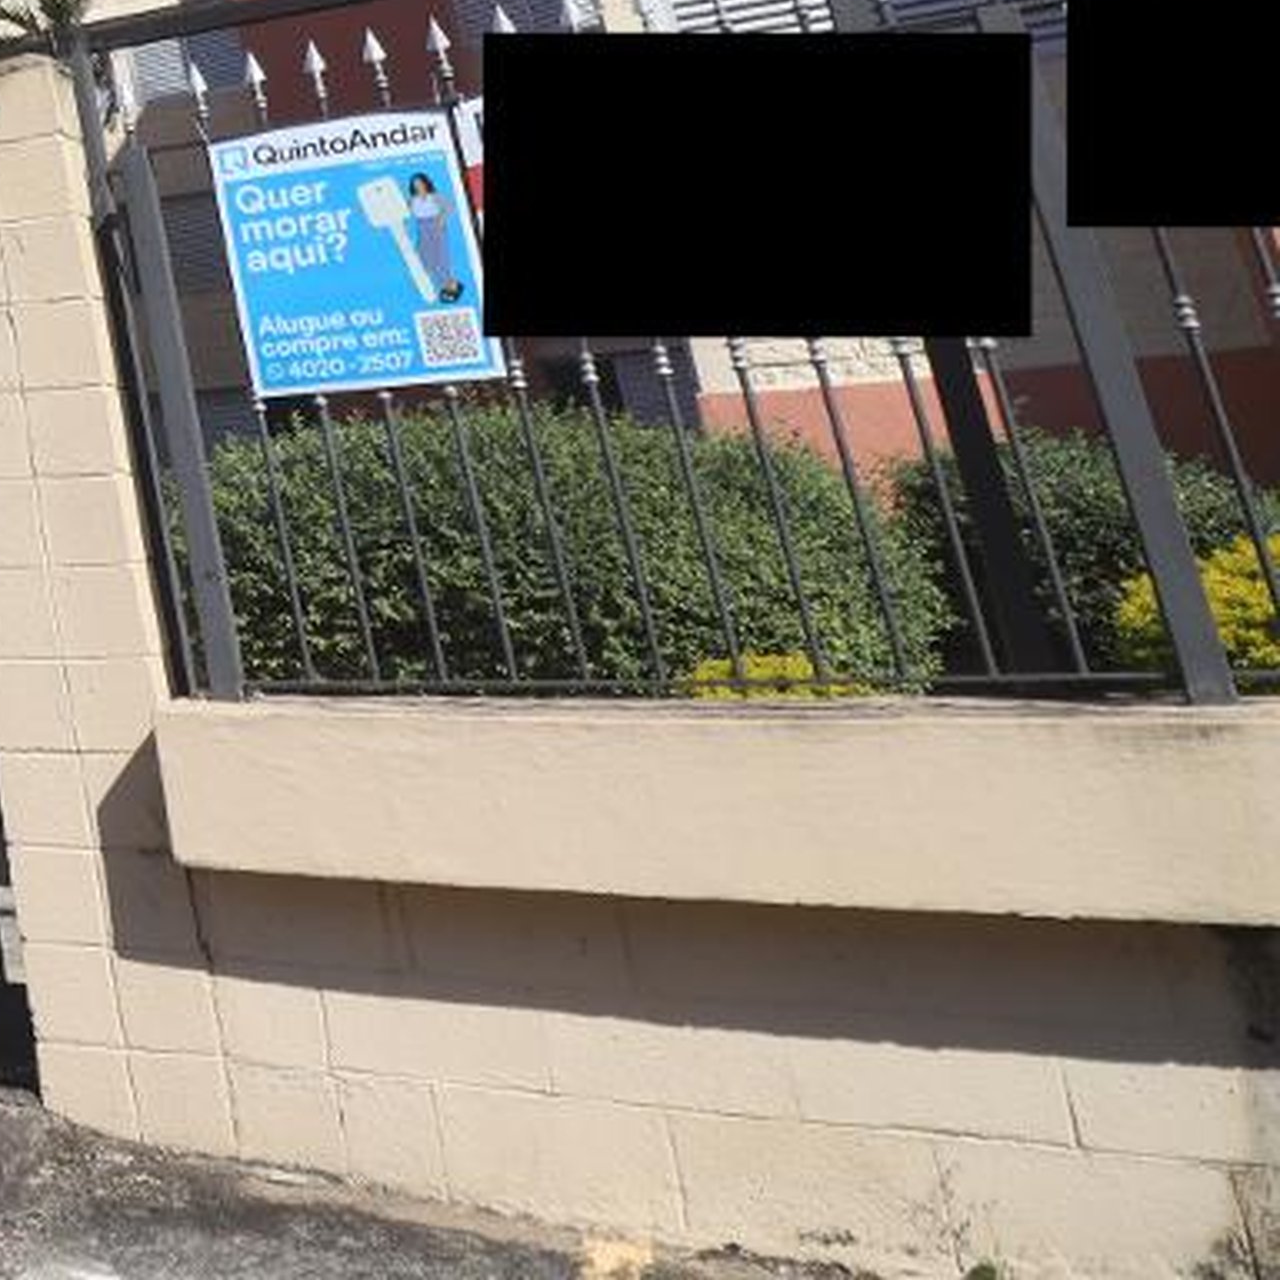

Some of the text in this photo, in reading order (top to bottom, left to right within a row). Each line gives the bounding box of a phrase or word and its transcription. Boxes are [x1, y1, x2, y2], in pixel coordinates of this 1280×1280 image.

[252, 121, 438, 166] QuintoAndar
[235, 180, 328, 215] Quer
[239, 207, 352, 244] morar
[246, 232, 348, 275] aqui?
[259, 308, 383, 338] Alugue ou
[261, 327, 410, 359] compre em:
[287, 357, 345, 380] 4020
